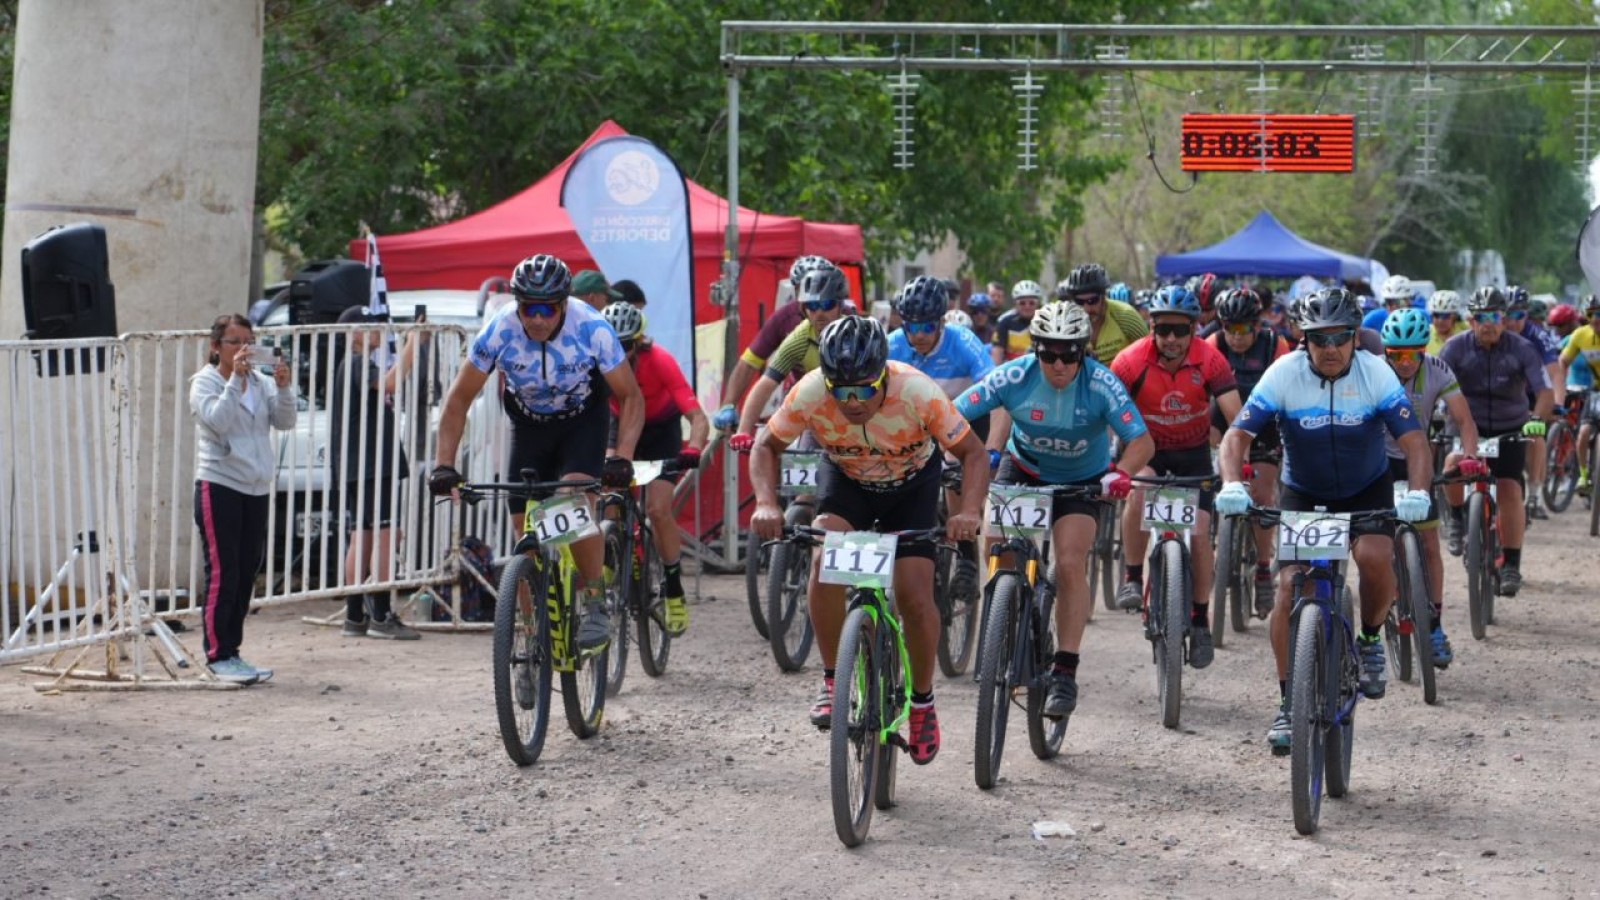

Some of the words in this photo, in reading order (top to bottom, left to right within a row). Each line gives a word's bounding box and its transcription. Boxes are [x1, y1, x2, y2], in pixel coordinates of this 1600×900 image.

[1092, 367, 1128, 407] BORA
[783, 469, 819, 486] 12
[536, 507, 590, 541] 103
[990, 505, 1047, 528] 112
[1145, 503, 1195, 524] 118
[1282, 526, 1343, 547] 102
[824, 548, 890, 573] 117
